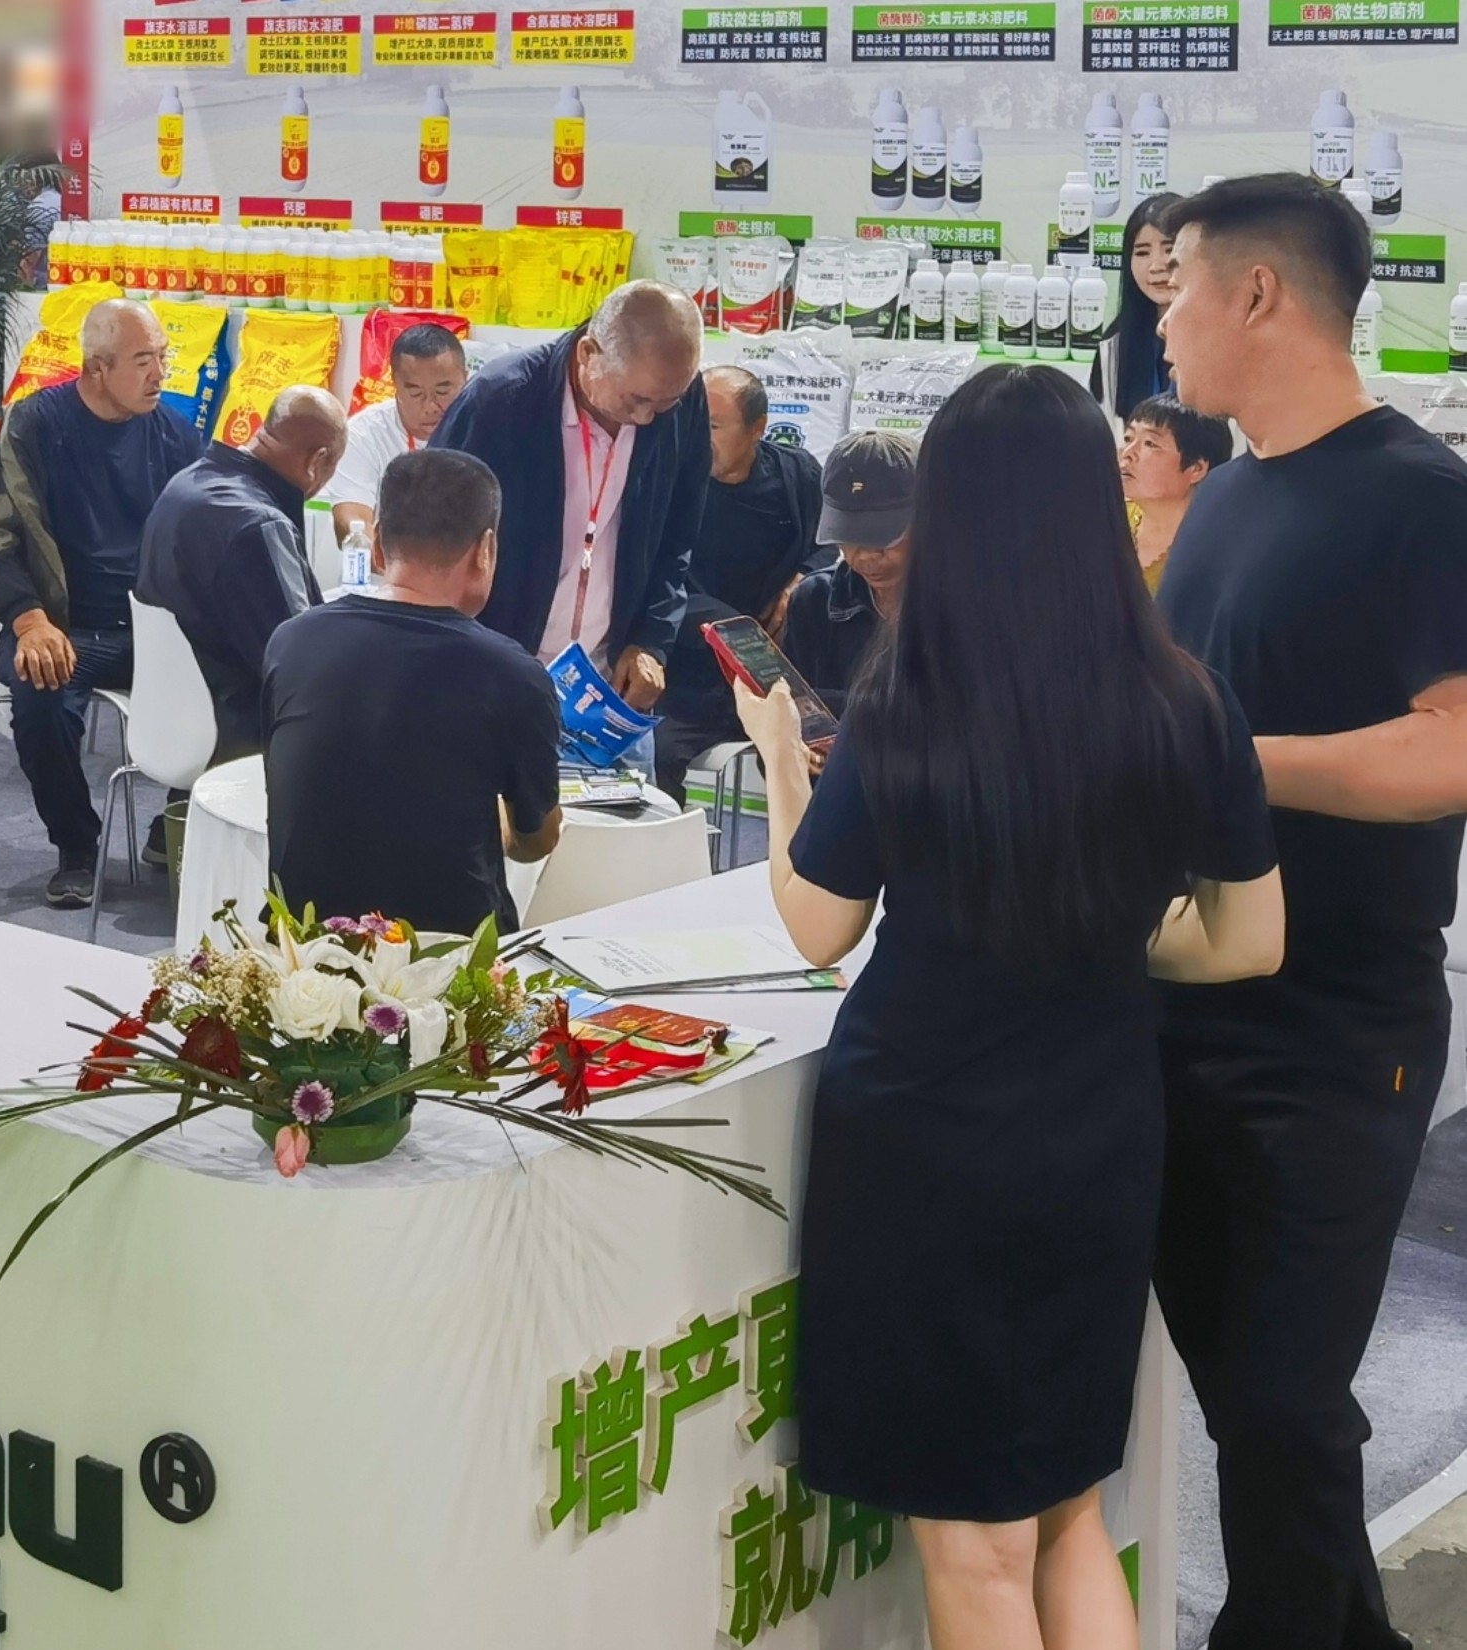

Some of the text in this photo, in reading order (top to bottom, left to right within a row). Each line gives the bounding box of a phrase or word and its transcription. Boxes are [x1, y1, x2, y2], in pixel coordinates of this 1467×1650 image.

[263, 18, 344, 33] 旗志颗粒水溶肥
[527, 13, 618, 29] 含氨基酸水溶肥料
[707, 10, 803, 27] 颗粒微生物菌剂
[144, 20, 209, 35] 旗志水溶菌肥
[1139, 27, 1181, 39] 培肥土壤
[1186, 27, 1230, 39] 调节酸碱
[1272, 28, 1456, 41] 沃土肥田 生根防病 增甜上色 增产提质
[733, 32, 773, 44] 改良土壤
[778, 32, 821, 44] 生根壮苗
[685, 48, 715, 60] 防烂根
[720, 48, 750, 60] 防死苗
[1186, 56, 1229, 68] 增产提质
[283, 201, 306, 216] 钙肥
[555, 210, 583, 226] 锌肥
[1400, 264, 1437, 278] 抗逆强
